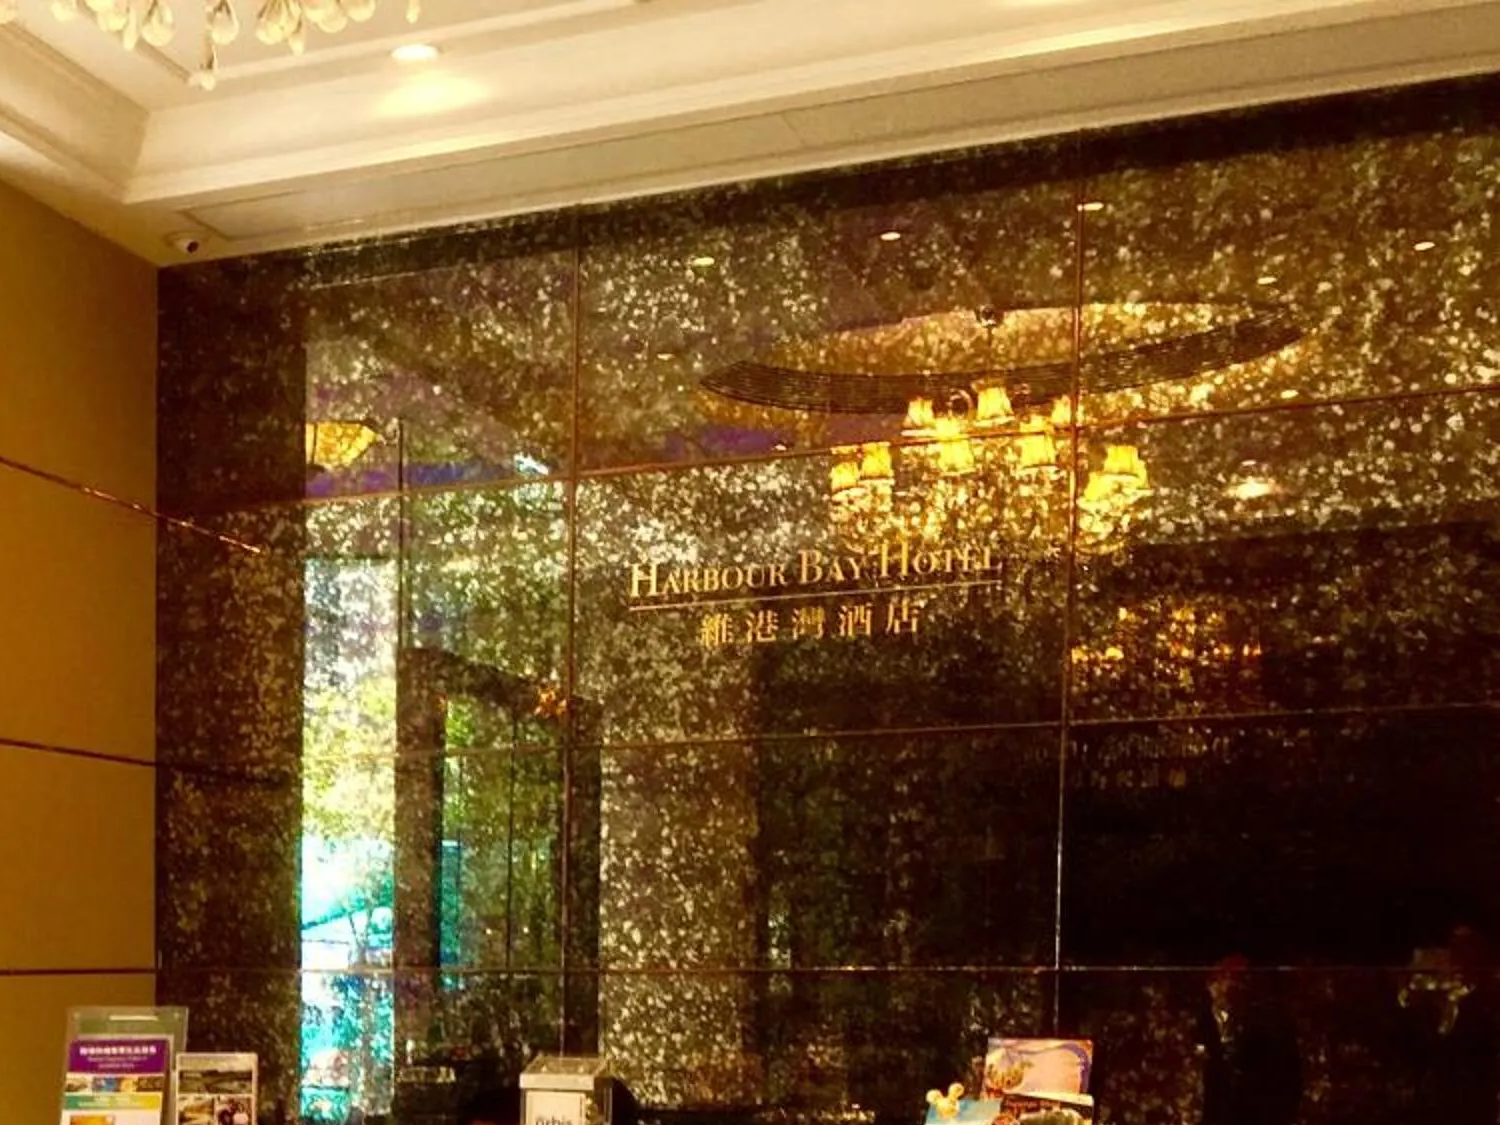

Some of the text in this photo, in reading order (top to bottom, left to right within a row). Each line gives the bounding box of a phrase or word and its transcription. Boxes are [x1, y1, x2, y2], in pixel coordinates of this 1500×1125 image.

[629, 539, 1003, 598] HARBOUR BAY HOTEL
